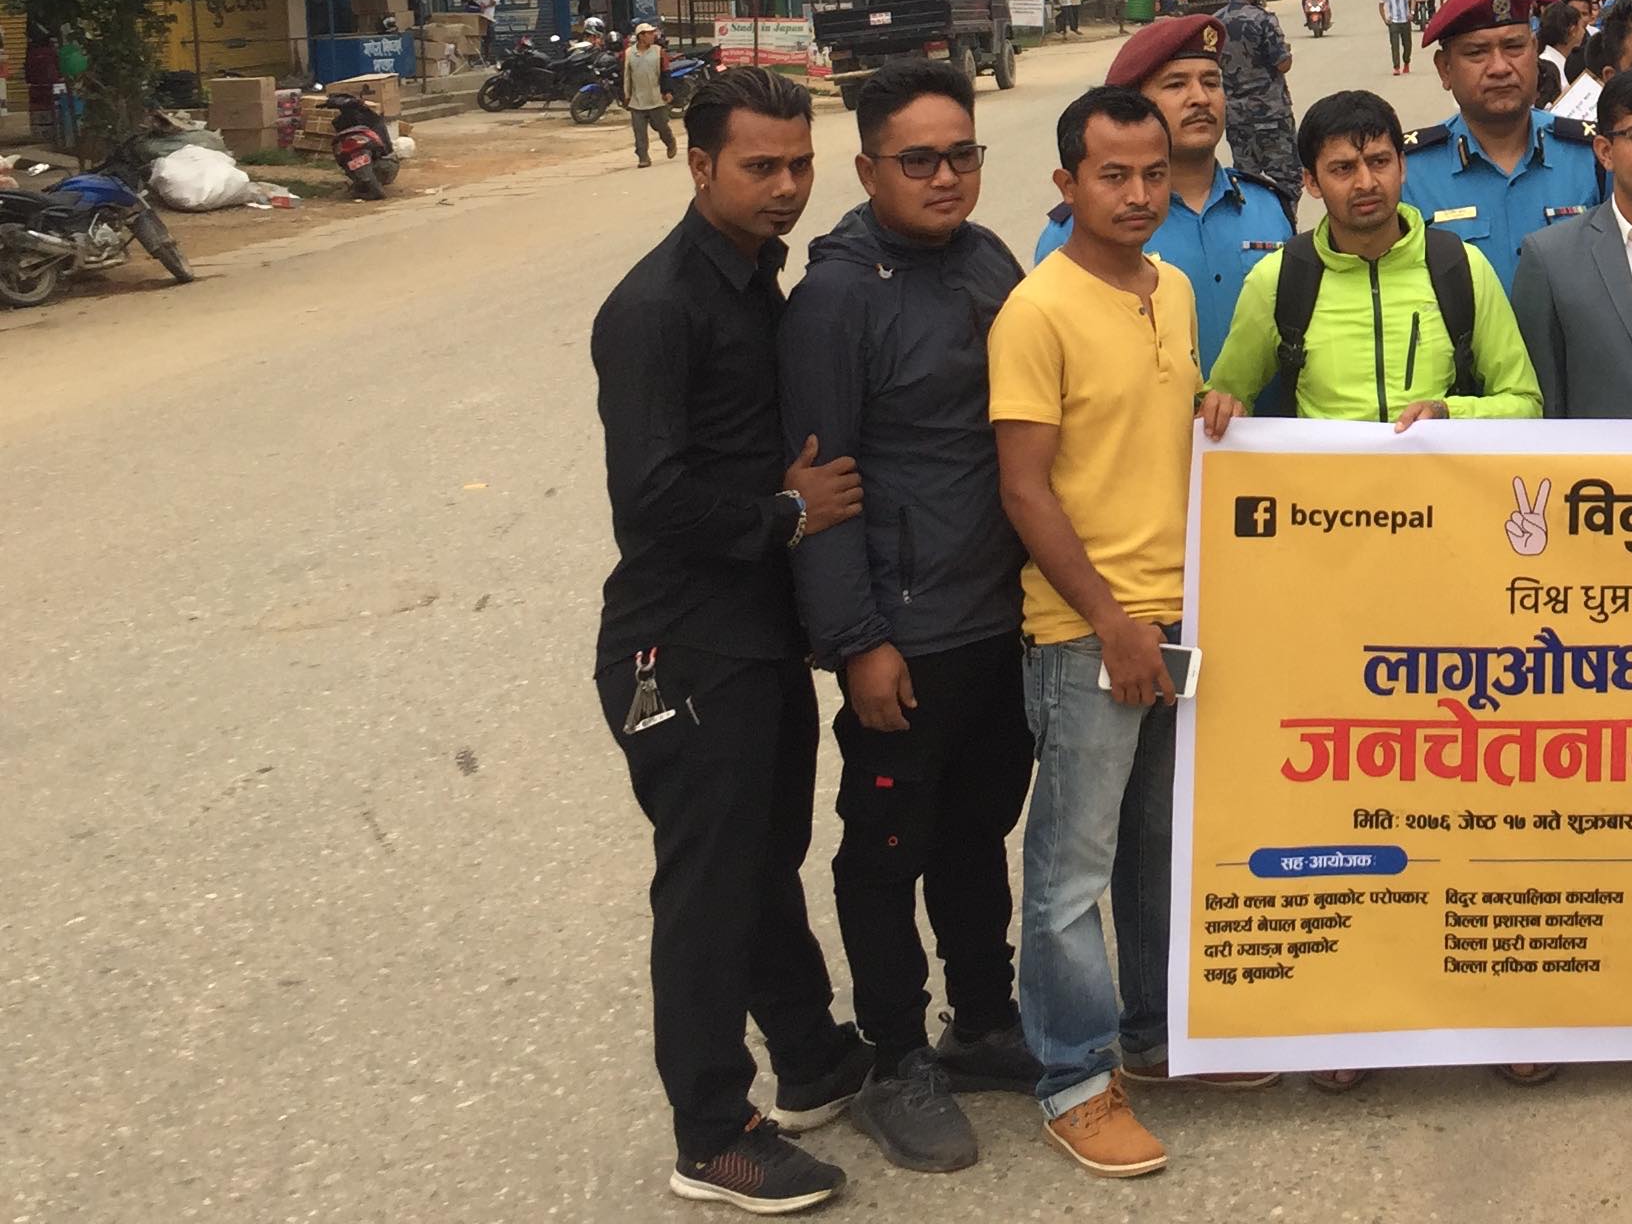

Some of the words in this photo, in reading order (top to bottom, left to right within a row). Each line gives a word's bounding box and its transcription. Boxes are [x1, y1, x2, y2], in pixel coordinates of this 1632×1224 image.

[773, 23, 803, 34] Japan
[1290, 504, 1434, 535] bcycnepal
[1506, 576, 1569, 615] विश्व
[1405, 814, 1451, 830] २०७६
[1458, 811, 1498, 830] जेष्ठ
[1503, 814, 1526, 830] १७
[1533, 810, 1561, 830] गते
[1205, 893, 1239, 911] लियो
[1244, 895, 1276, 909] क्लब
[1281, 894, 1309, 908] अफ
[1314, 889, 1365, 909] नुवाकोट
[1370, 888, 1430, 905] परोपकार
[1446, 888, 1478, 908] विदुर
[1482, 888, 1561, 904] नगरपालिका
[1566, 889, 1624, 904] कार्यालय
[1258, 915, 1296, 932] नेपाल
[1301, 913, 1352, 934] नुवाकोट
[1445, 911, 1488, 928] जिल्ला
[1493, 914, 1541, 929] प्रशासन
[1545, 911, 1603, 927] कार्यालय
[1205, 941, 1232, 958] दारी
[1287, 937, 1339, 958] नुवाकोट
[1445, 933, 1487, 950] जिल्ला
[1493, 934, 1524, 951] प्रहरी
[1529, 934, 1587, 950] कार्यालय
[1242, 963, 1294, 984] नुवाकोट
[1444, 956, 1487, 973] जिल्ला
[1492, 956, 1538, 976] ट्राफिक
[1542, 957, 1601, 972] कार्यालय
